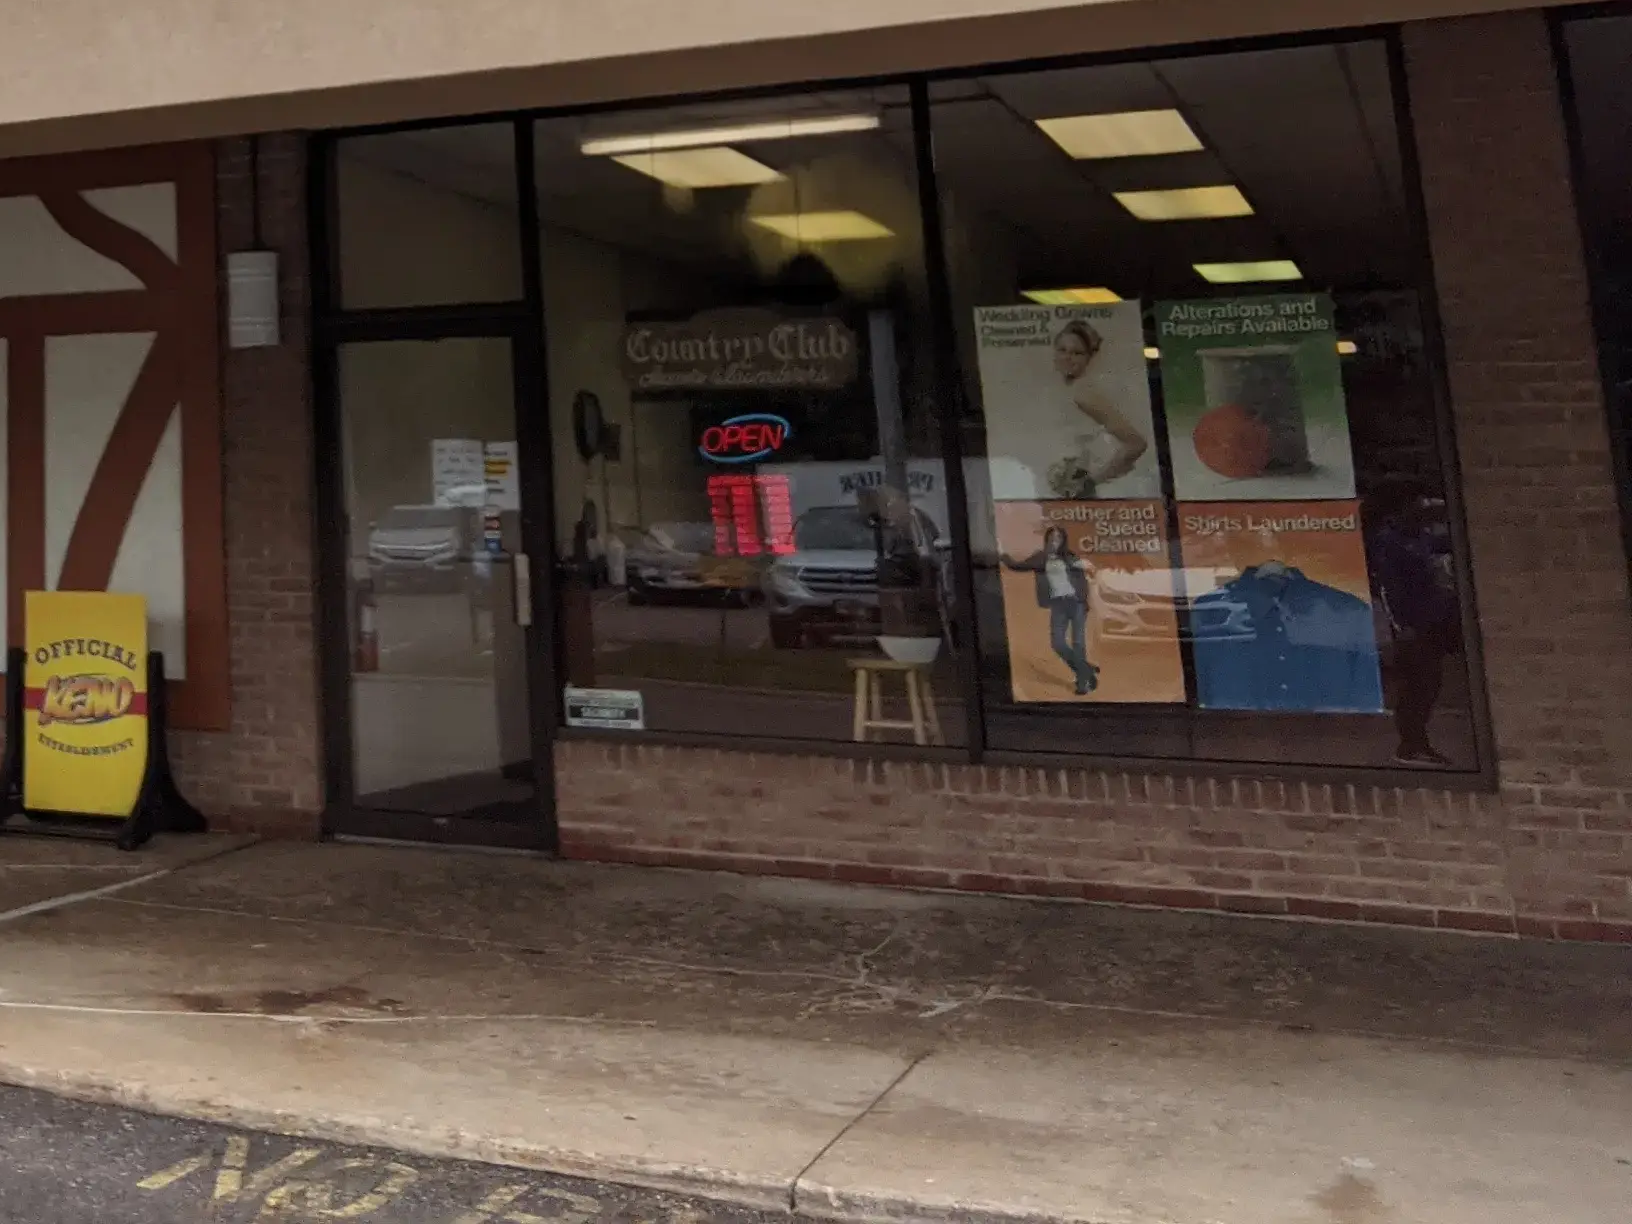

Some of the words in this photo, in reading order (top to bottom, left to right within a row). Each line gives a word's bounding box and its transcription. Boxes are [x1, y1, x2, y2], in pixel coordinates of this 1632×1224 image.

[1169, 302, 1274, 320] Alterations
[1279, 298, 1317, 316] and
[1161, 320, 1236, 338] Repairs
[1240, 315, 1329, 334] Available
[626, 329, 764, 364] Country
[769, 324, 850, 360] Club
[702, 425, 783, 453] OPEN
[1040, 504, 1113, 522] Leather
[1118, 503, 1156, 520] and
[1184, 515, 1243, 532] Shirts
[1247, 513, 1357, 532] Laundered
[1095, 518, 1157, 536] Suede
[1078, 535, 1162, 554] Cleaned
[35, 638, 137, 670] OFFICIAL
[38, 674, 135, 727] KENO
